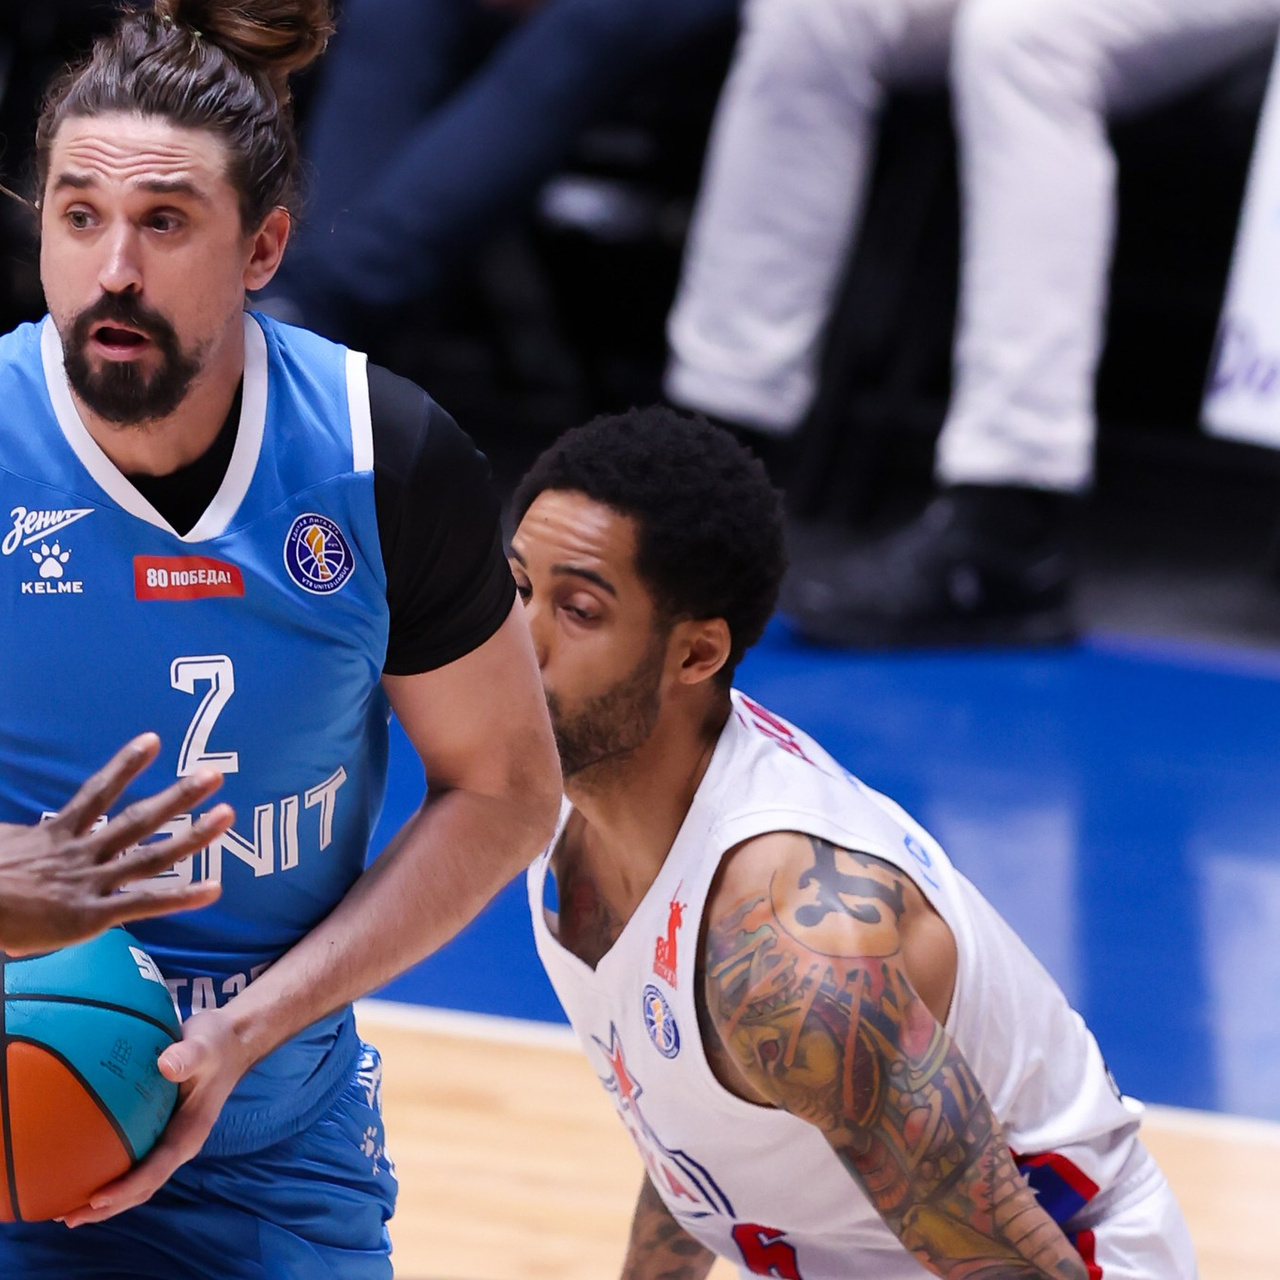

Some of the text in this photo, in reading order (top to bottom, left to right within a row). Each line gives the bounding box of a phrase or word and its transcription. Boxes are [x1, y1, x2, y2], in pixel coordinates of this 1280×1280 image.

[21, 581, 83, 594] KELME
[146, 568, 231, 588] 80 ПОБЕДА!
[170, 654, 239, 777] 2
